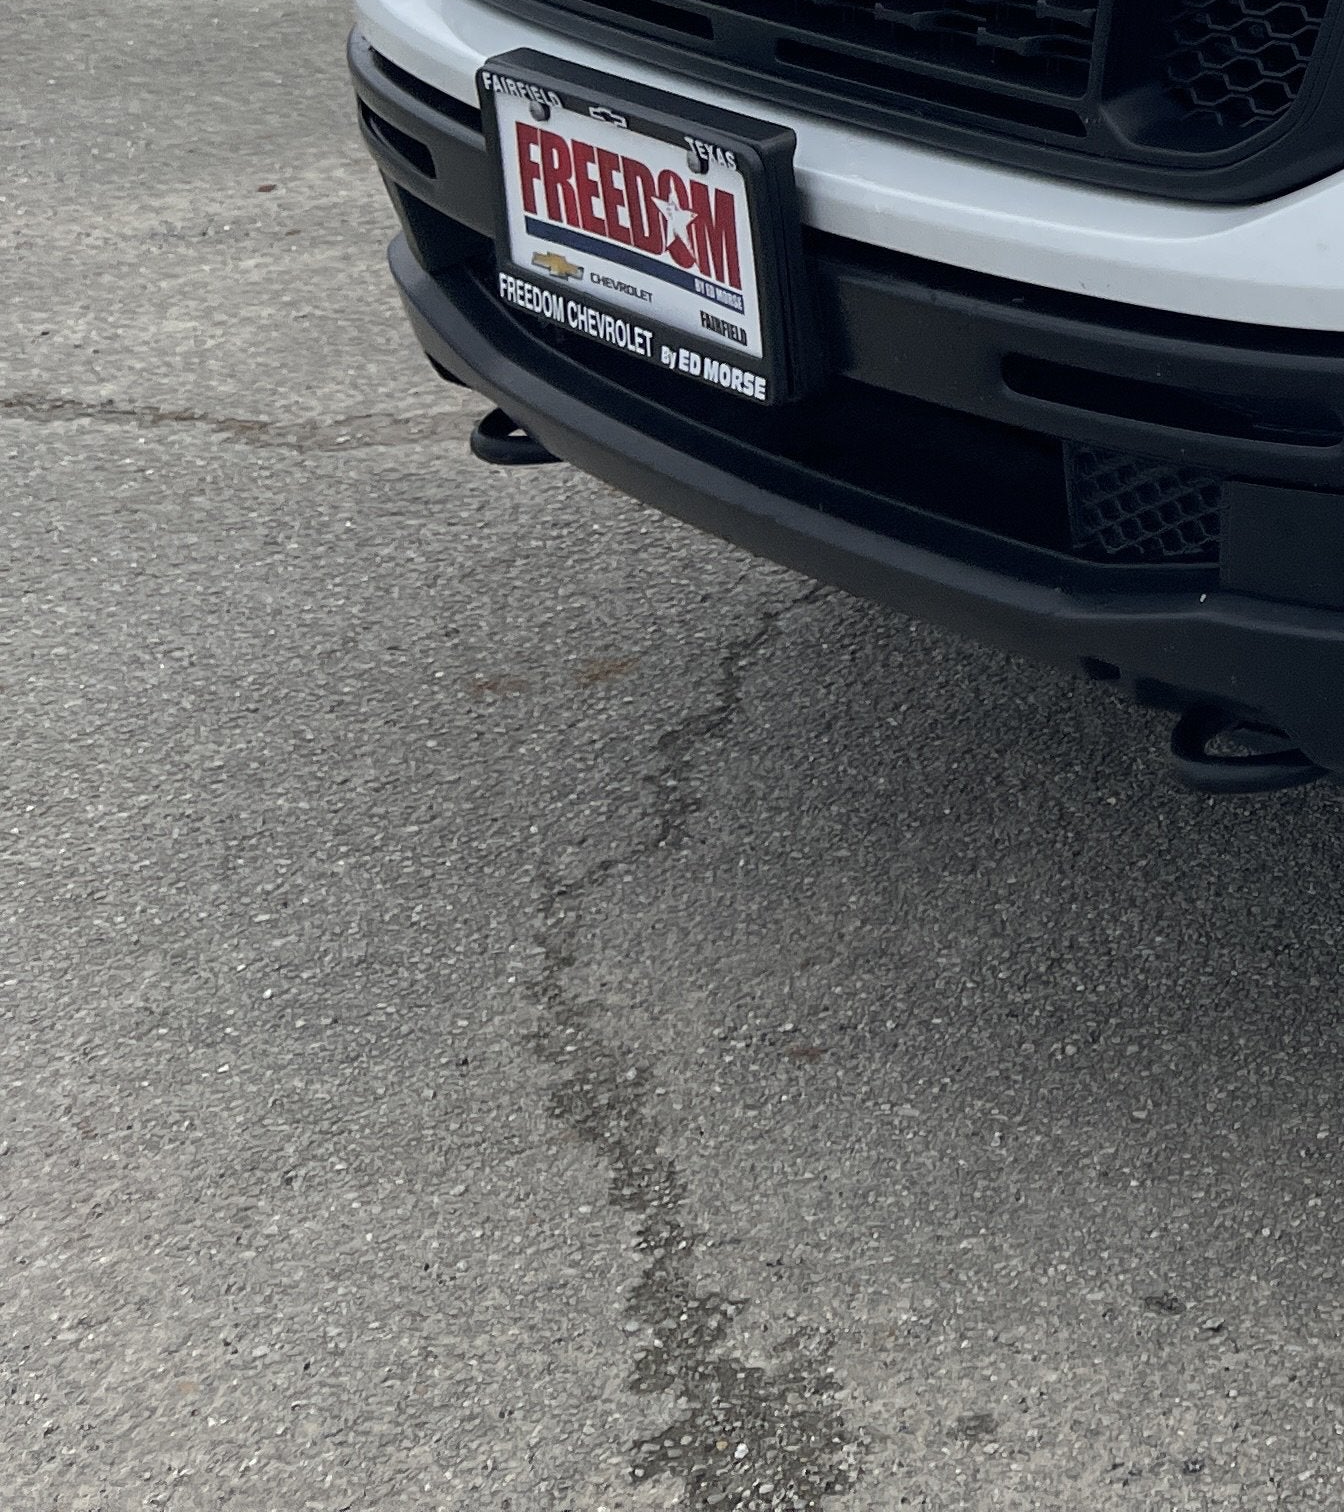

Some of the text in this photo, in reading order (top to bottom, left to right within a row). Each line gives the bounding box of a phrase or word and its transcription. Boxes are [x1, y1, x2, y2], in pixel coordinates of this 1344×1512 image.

[482, 71, 562, 109] FAIRFIELD
[684, 137, 737, 170] TEXAS
[515, 121, 742, 290] FREEDOM
[590, 272, 653, 303] CHEVROLET
[500, 273, 565, 324] FREEDOM
[567, 304, 653, 357] CHEVROLET
[678, 348, 701, 377] ED
[703, 358, 766, 401] MORSE
